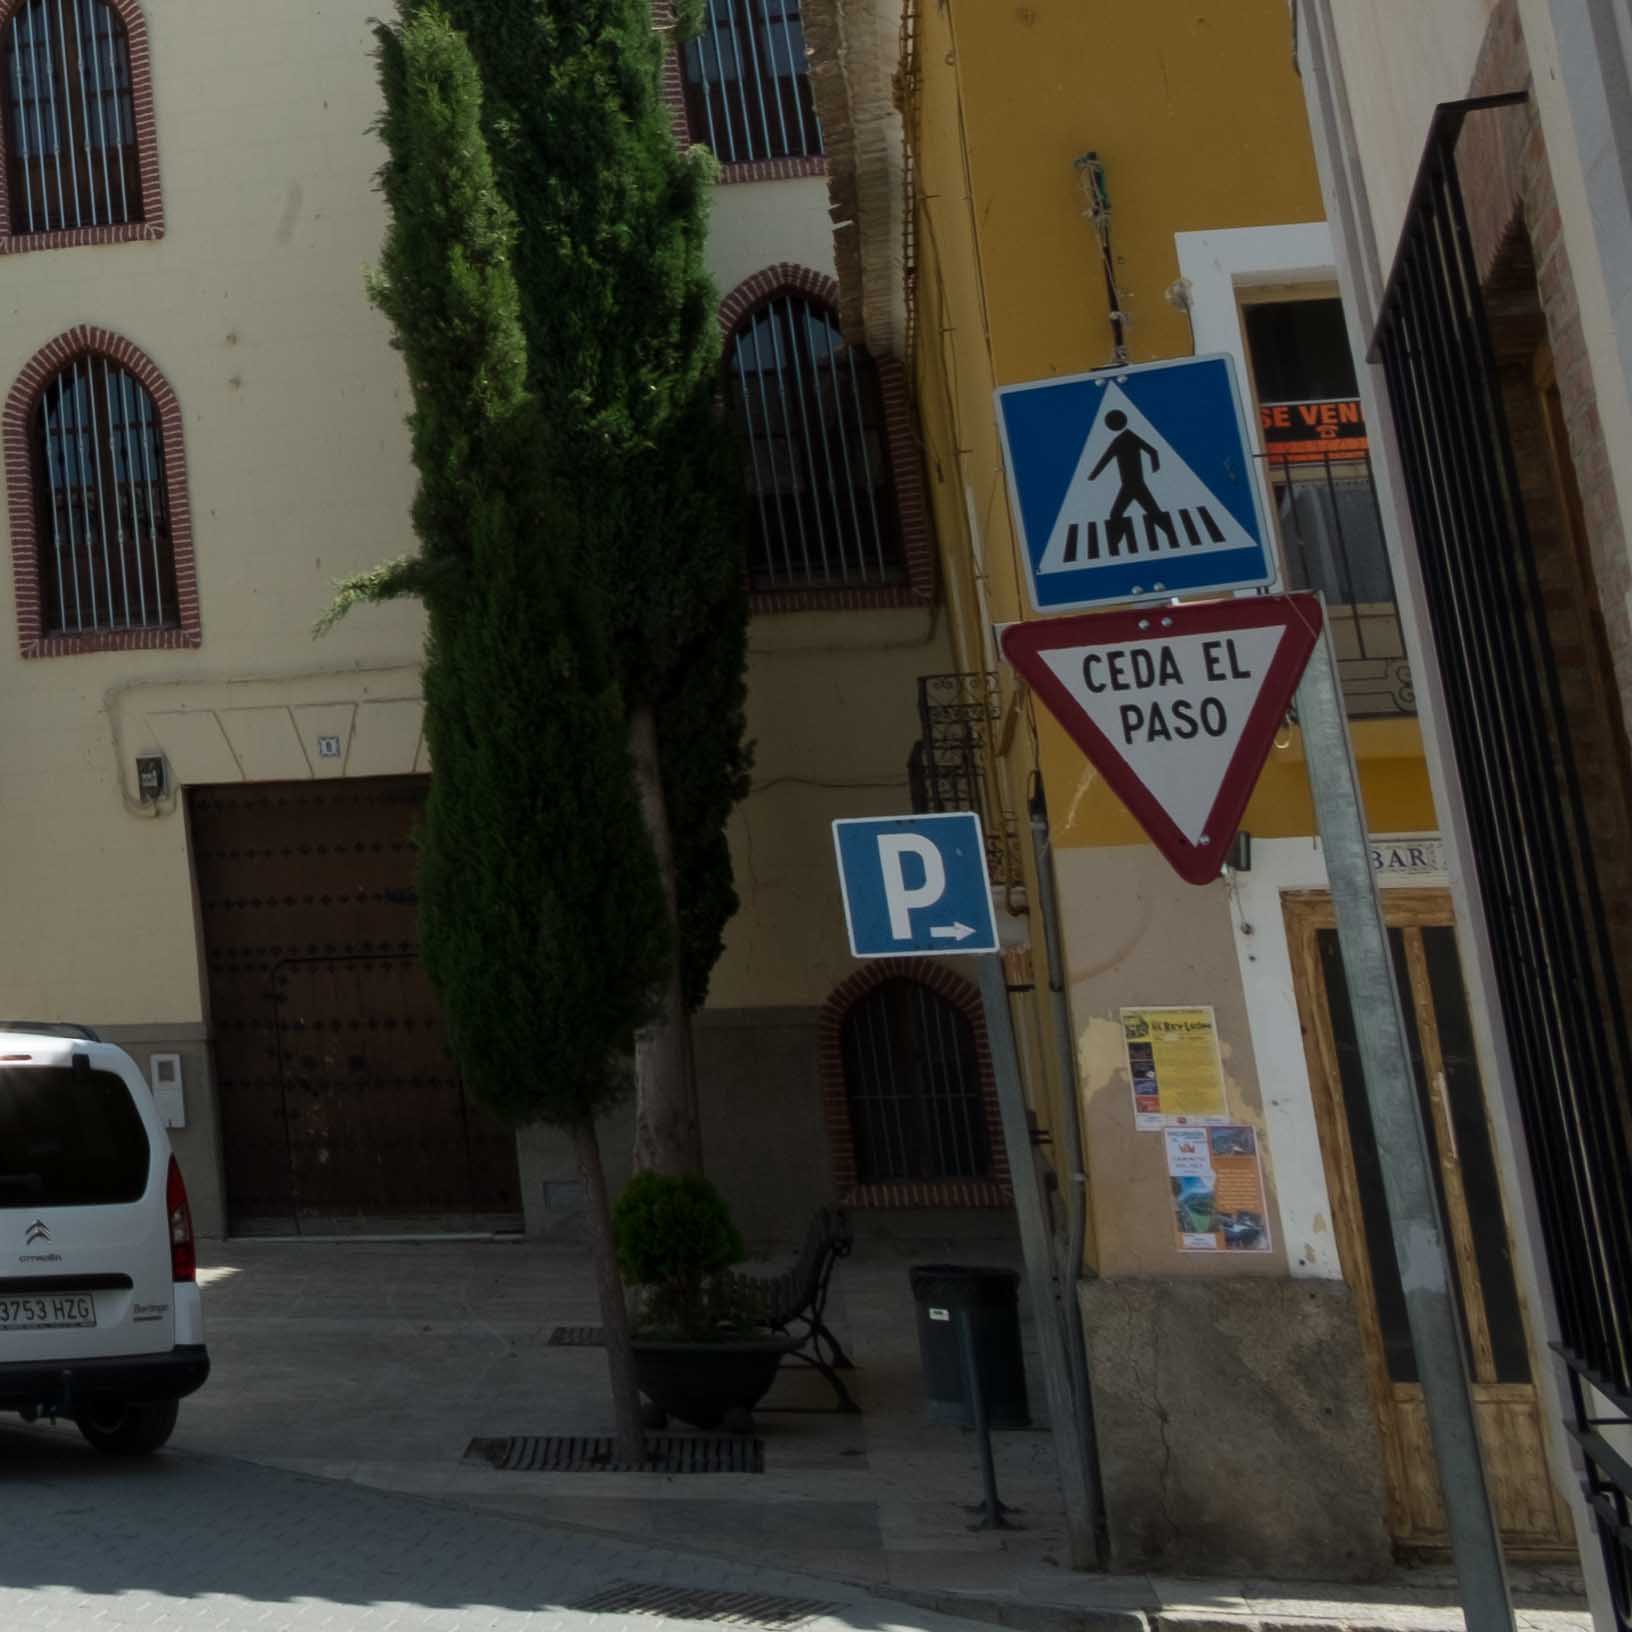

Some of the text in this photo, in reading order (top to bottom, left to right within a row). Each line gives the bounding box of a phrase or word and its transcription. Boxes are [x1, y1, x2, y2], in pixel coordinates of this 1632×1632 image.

[1261, 401, 1362, 429] SE VEN
[1083, 638, 1252, 693] CEDA EL
[1120, 697, 1227, 744] PASO
[877, 833, 946, 940] P
[0, 1298, 90, 1322] 3753 HZG
